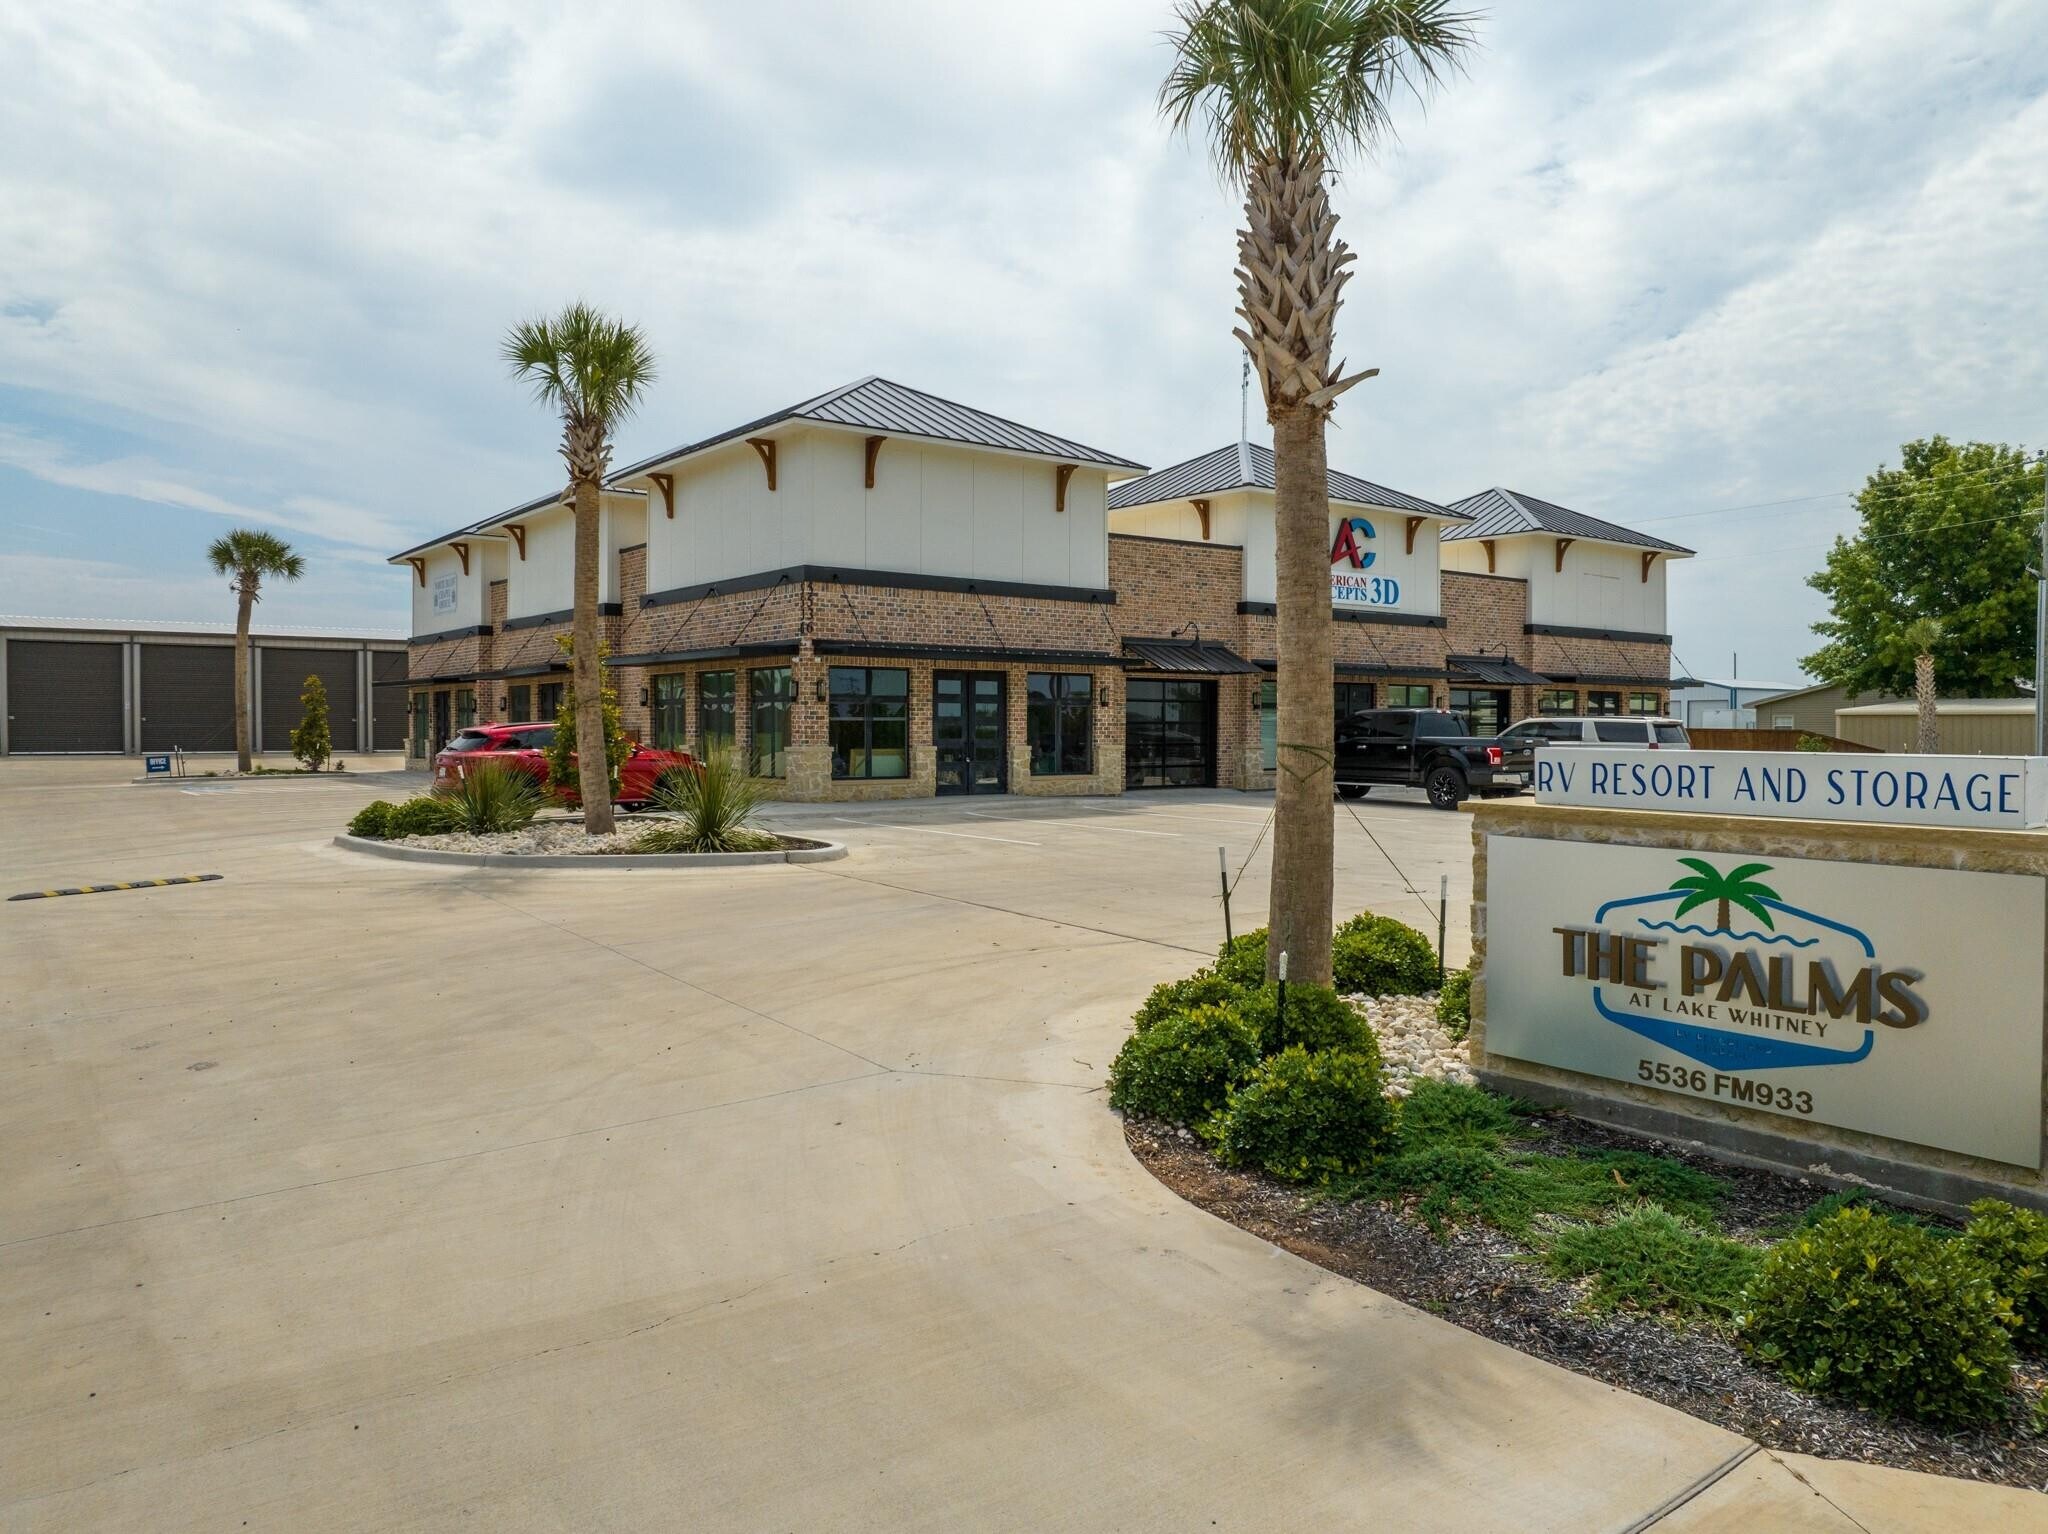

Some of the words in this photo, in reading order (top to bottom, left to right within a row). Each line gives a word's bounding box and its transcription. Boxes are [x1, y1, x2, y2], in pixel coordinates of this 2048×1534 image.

[1331, 575, 1367, 588] ERICAN
[1331, 586, 1367, 601] CEPTS
[1370, 577, 1399, 605] 3D
[149, 758, 167, 766] OFFICE
[1538, 761, 1576, 793] RV
[1592, 763, 1715, 799] RESORT
[1734, 767, 1807, 803] AND
[1827, 769, 2020, 814] STORAGE
[1553, 927, 1658, 990] THE
[1681, 945, 1920, 1029] PALMS
[1629, 992, 1653, 1008] AT
[1663, 997, 1718, 1020] LAKE
[1728, 1007, 1829, 1038] WHITNEY
[1637, 1059, 1707, 1092] 5536
[1713, 1073, 1814, 1114] FM933
